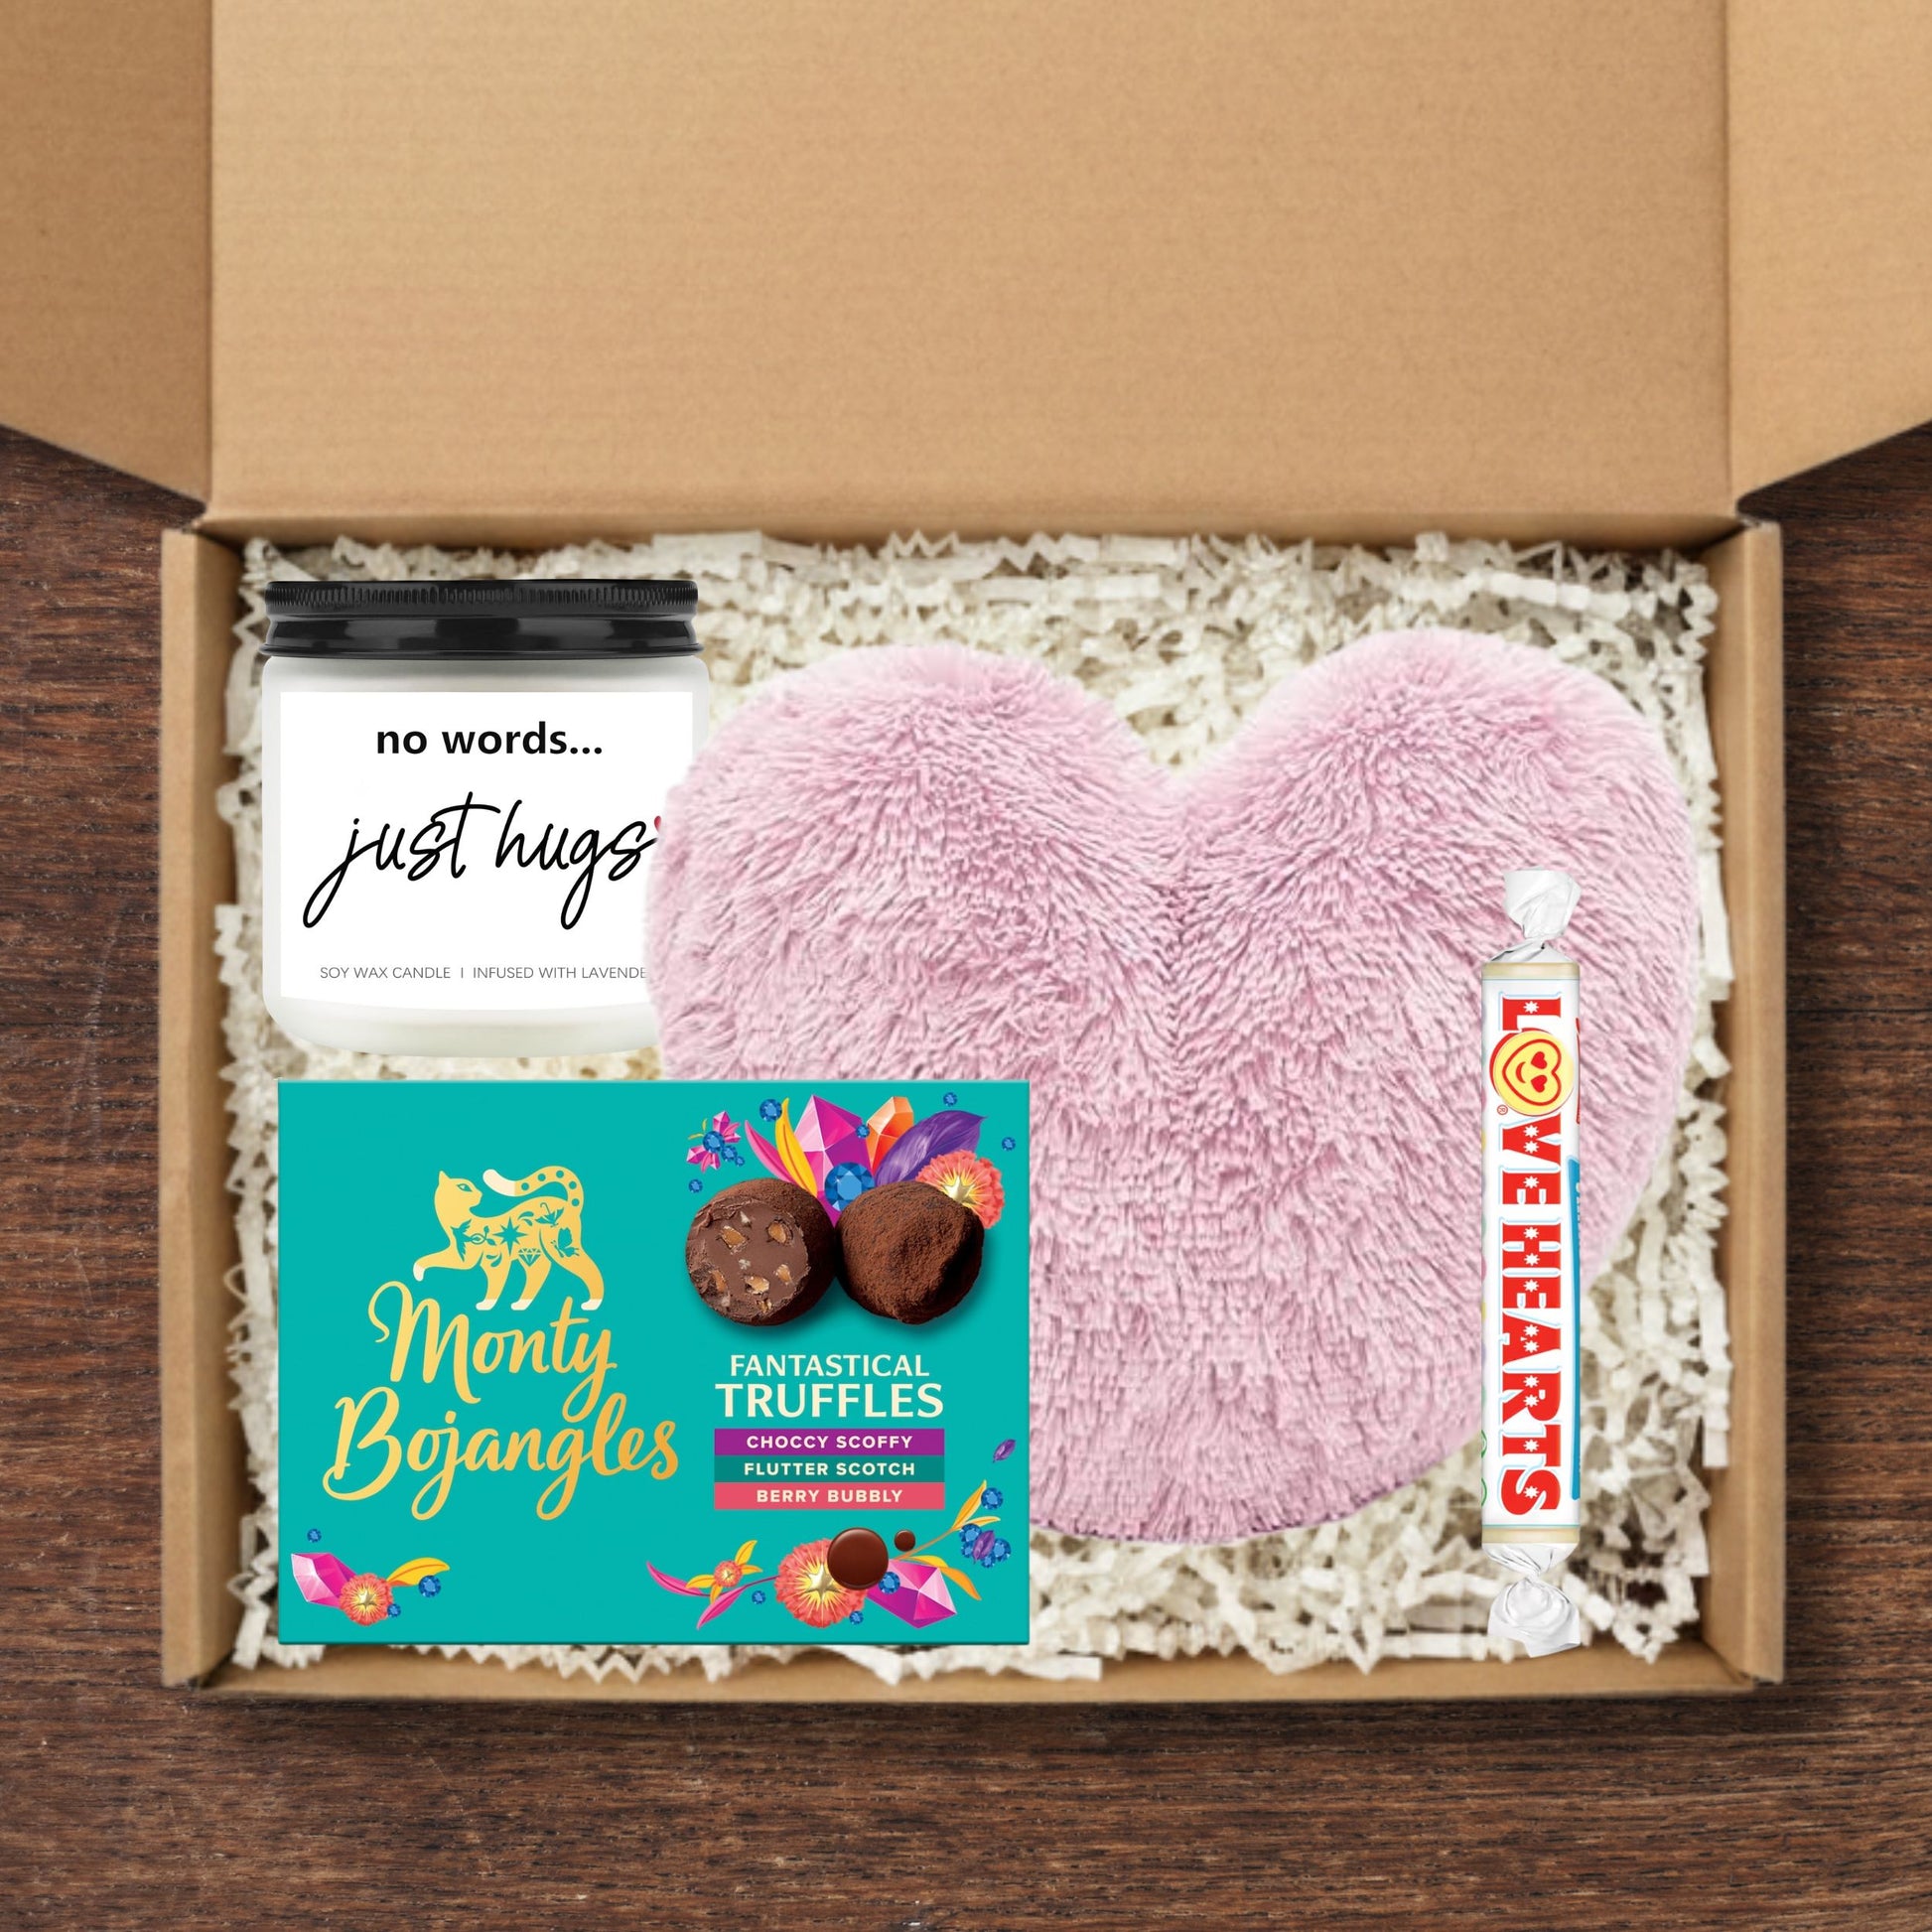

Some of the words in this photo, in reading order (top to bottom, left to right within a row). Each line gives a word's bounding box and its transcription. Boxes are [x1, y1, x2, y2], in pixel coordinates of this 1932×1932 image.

[377, 729, 428, 755] no
[441, 720, 604, 756] words...
[302, 791, 501, 929] just
[495, 799, 656, 930] hugs
[320, 966, 350, 980] SOY
[353, 966, 389, 980] WAX
[392, 966, 452, 980] CANDLE
[473, 966, 534, 980] INFUSED
[538, 966, 577, 980] WITH
[581, 966, 647, 980] LAVENDE
[368, 1280, 619, 1424] Monty
[730, 1354, 930, 1378] FANTASTICAL
[1499, 1221, 1562, 1516] HEARTS
[714, 1383, 943, 1419] TRUFFLES
[322, 1386, 679, 1521] Bojangles
[746, 1434, 829, 1449] CHOCCY
[836, 1434, 912, 1449] SCOFFY
[744, 1461, 828, 1477] FLUTTER
[835, 1461, 915, 1477] SCOTCH
[757, 1488, 820, 1504] BERRY
[827, 1488, 902, 1504] BUBBLY
